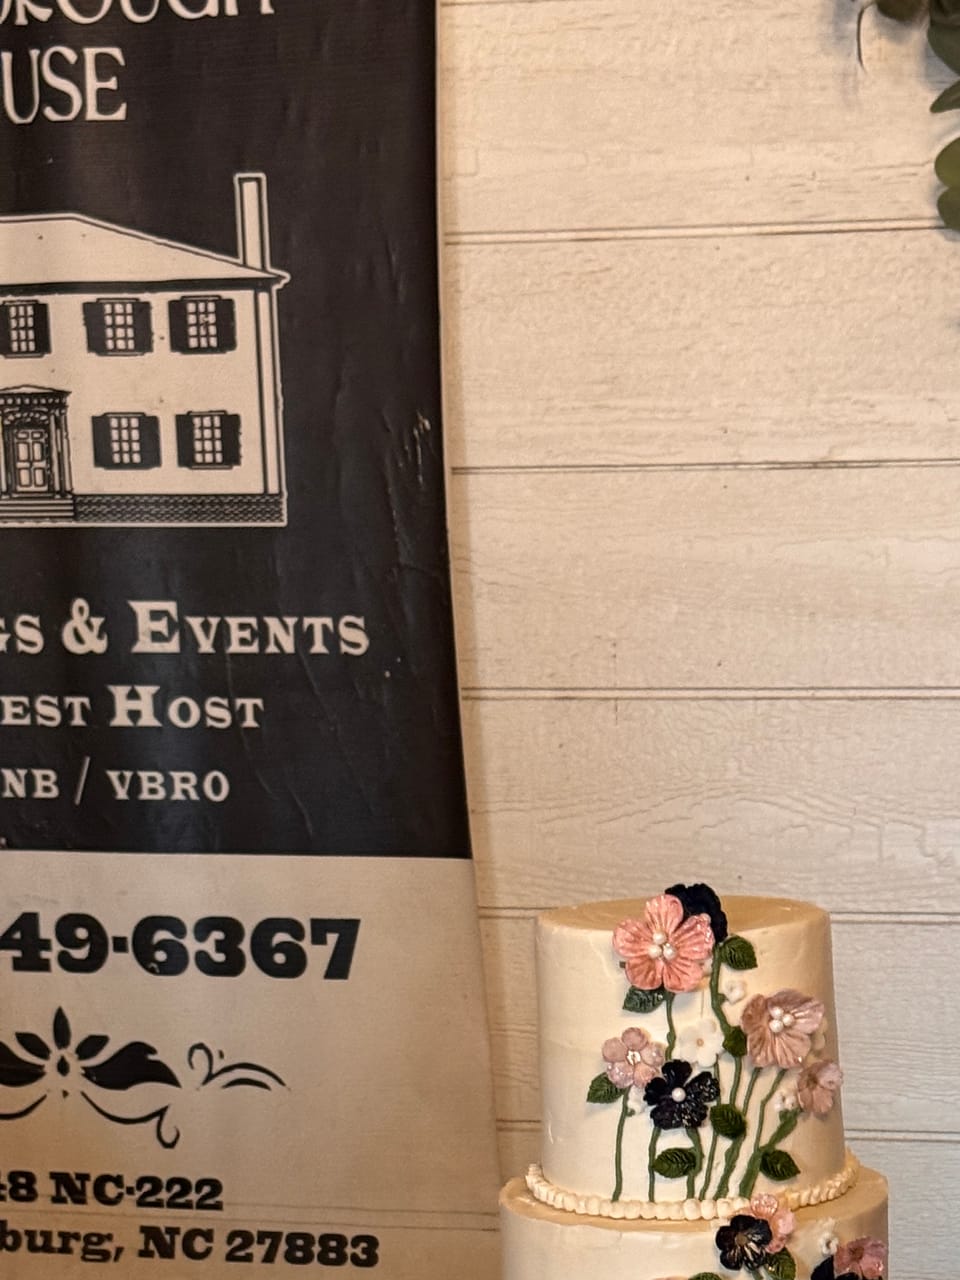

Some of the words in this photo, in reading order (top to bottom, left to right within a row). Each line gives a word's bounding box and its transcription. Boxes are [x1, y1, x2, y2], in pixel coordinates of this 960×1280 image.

[0, 45, 127, 124] USE
[62, 598, 108, 655] &
[128, 600, 370, 655] EVENTS
[0, 695, 92, 727] EST
[107, 685, 264, 728] HOST
[1, 768, 59, 798] NB
[106, 770, 230, 801] VBRO
[138, 1225, 214, 1260] NC
[225, 1229, 380, 1267] 27883
